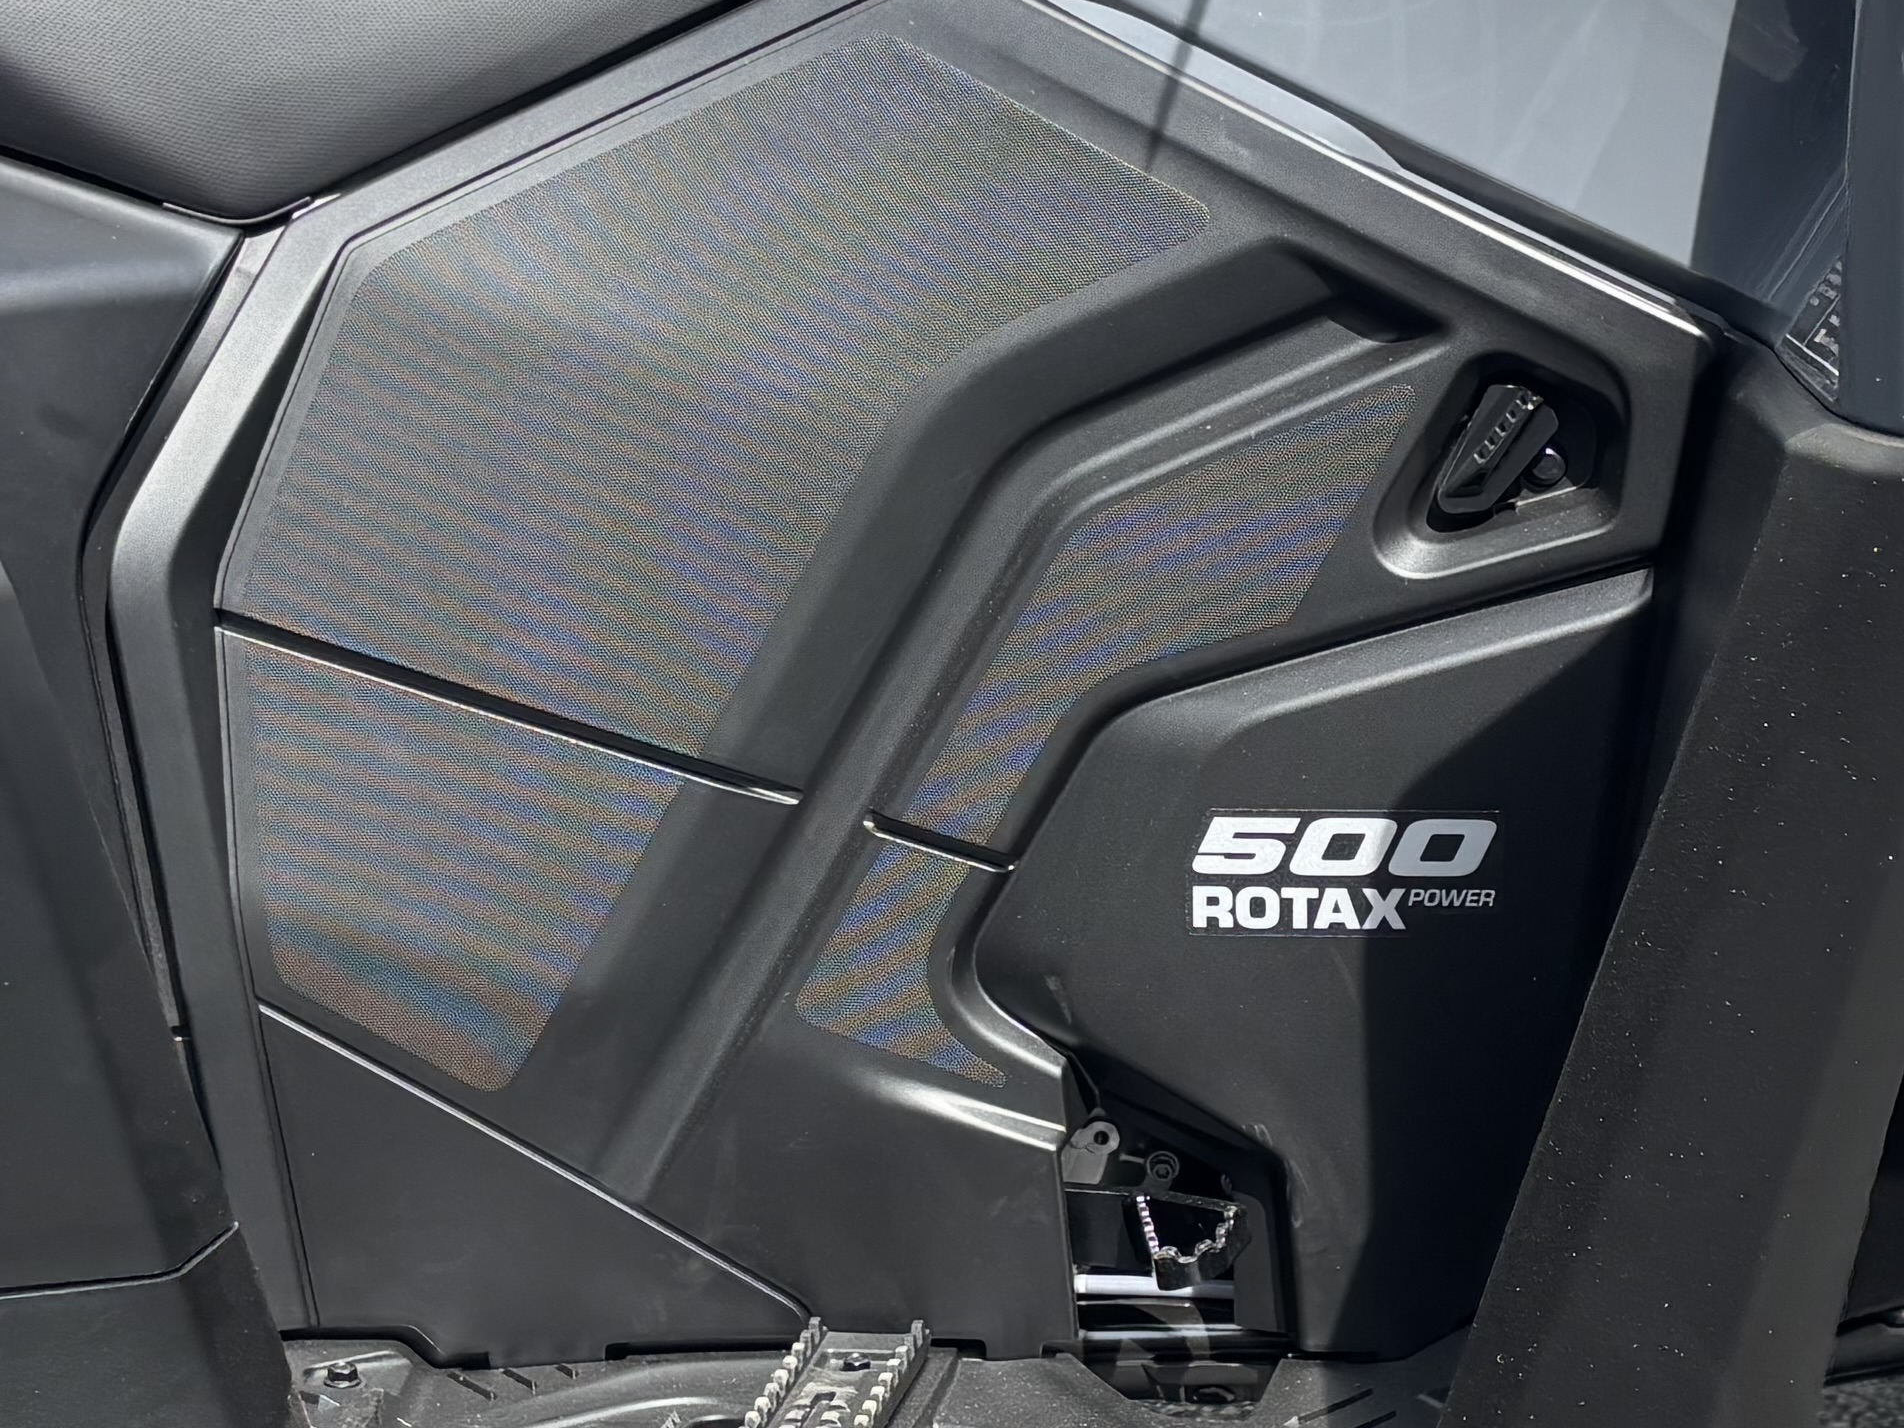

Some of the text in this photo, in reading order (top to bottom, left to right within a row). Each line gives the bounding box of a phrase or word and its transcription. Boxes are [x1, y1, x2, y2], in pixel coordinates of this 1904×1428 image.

[1192, 816, 1499, 878] 500
[1192, 886, 1496, 931] ROTAX POWER
